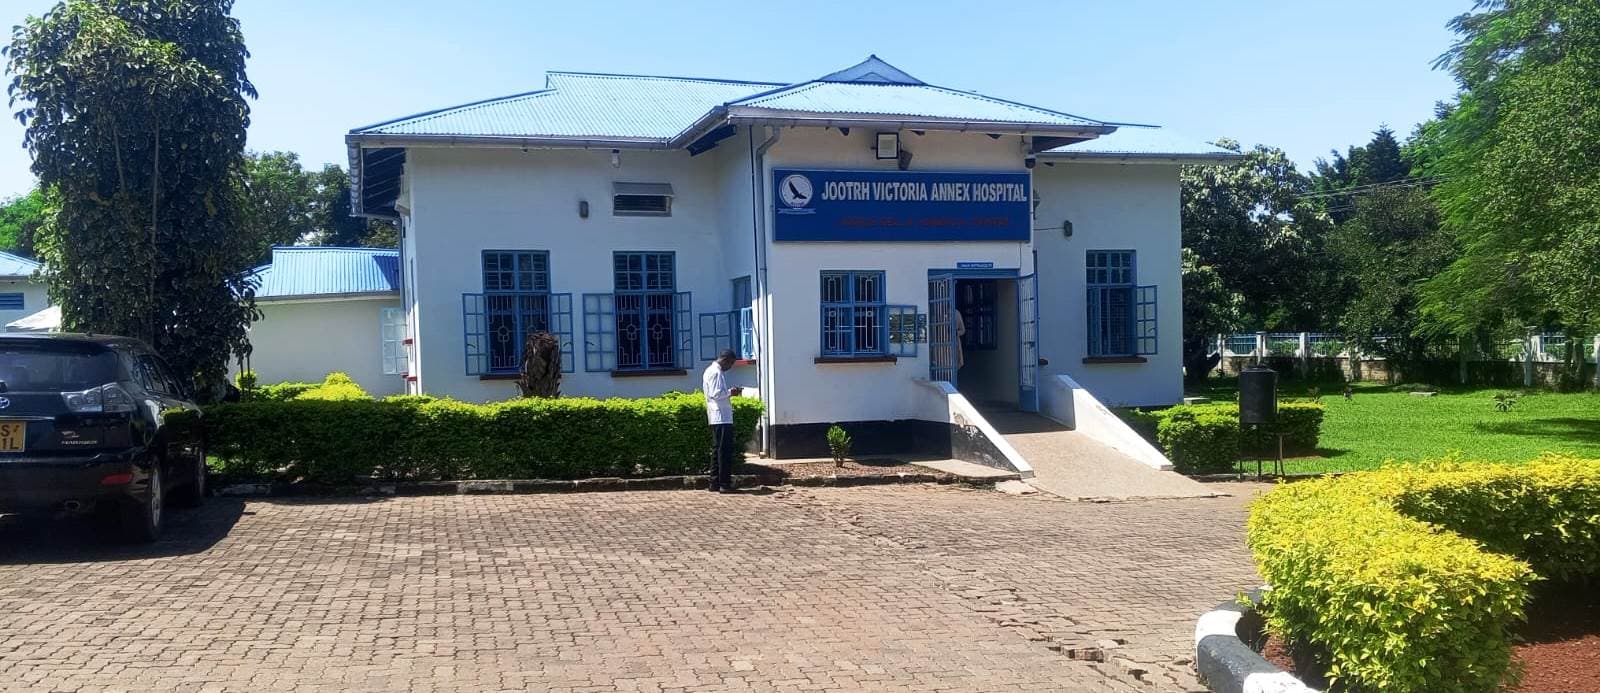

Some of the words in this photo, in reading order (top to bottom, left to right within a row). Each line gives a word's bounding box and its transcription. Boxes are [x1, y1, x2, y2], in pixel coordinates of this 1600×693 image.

[822, 181, 870, 200] JOOTRH
[872, 181, 928, 201] VICTORIA
[931, 182, 970, 201] ANNEX
[973, 183, 1027, 202] HOSPITAL
